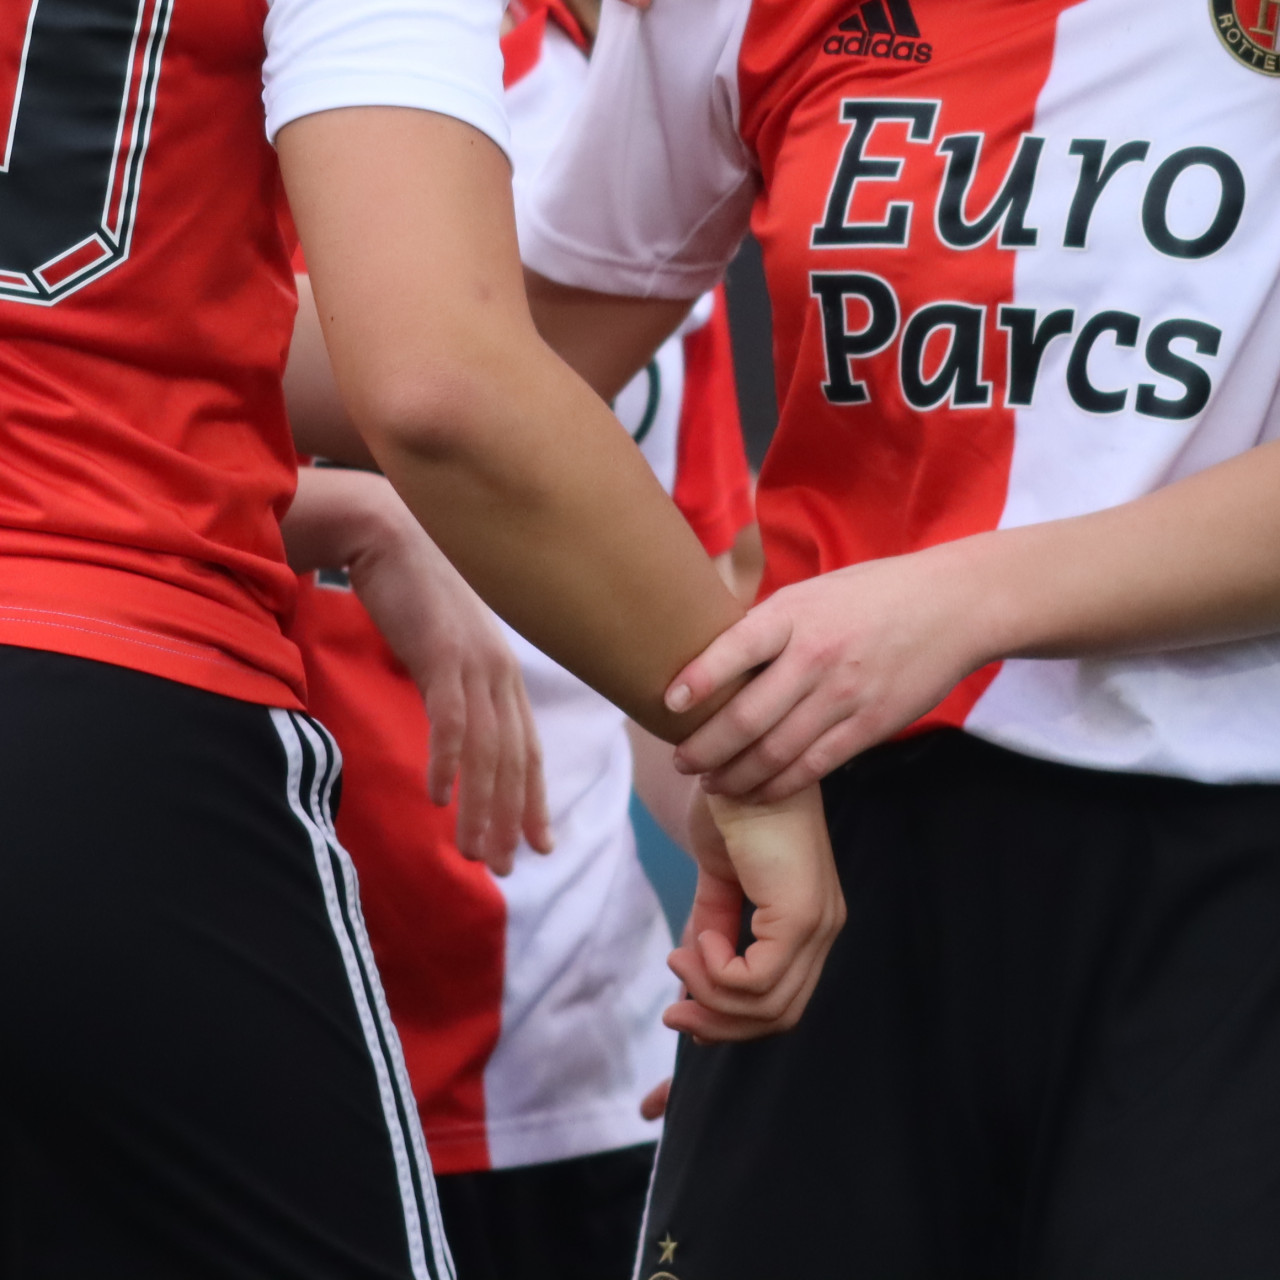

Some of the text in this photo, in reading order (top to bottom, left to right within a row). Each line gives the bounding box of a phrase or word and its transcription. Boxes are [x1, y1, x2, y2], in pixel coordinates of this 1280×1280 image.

[823, 30, 933, 64] adidas
[809, 97, 1247, 260] Euro
[810, 270, 1223, 421] Parcs
